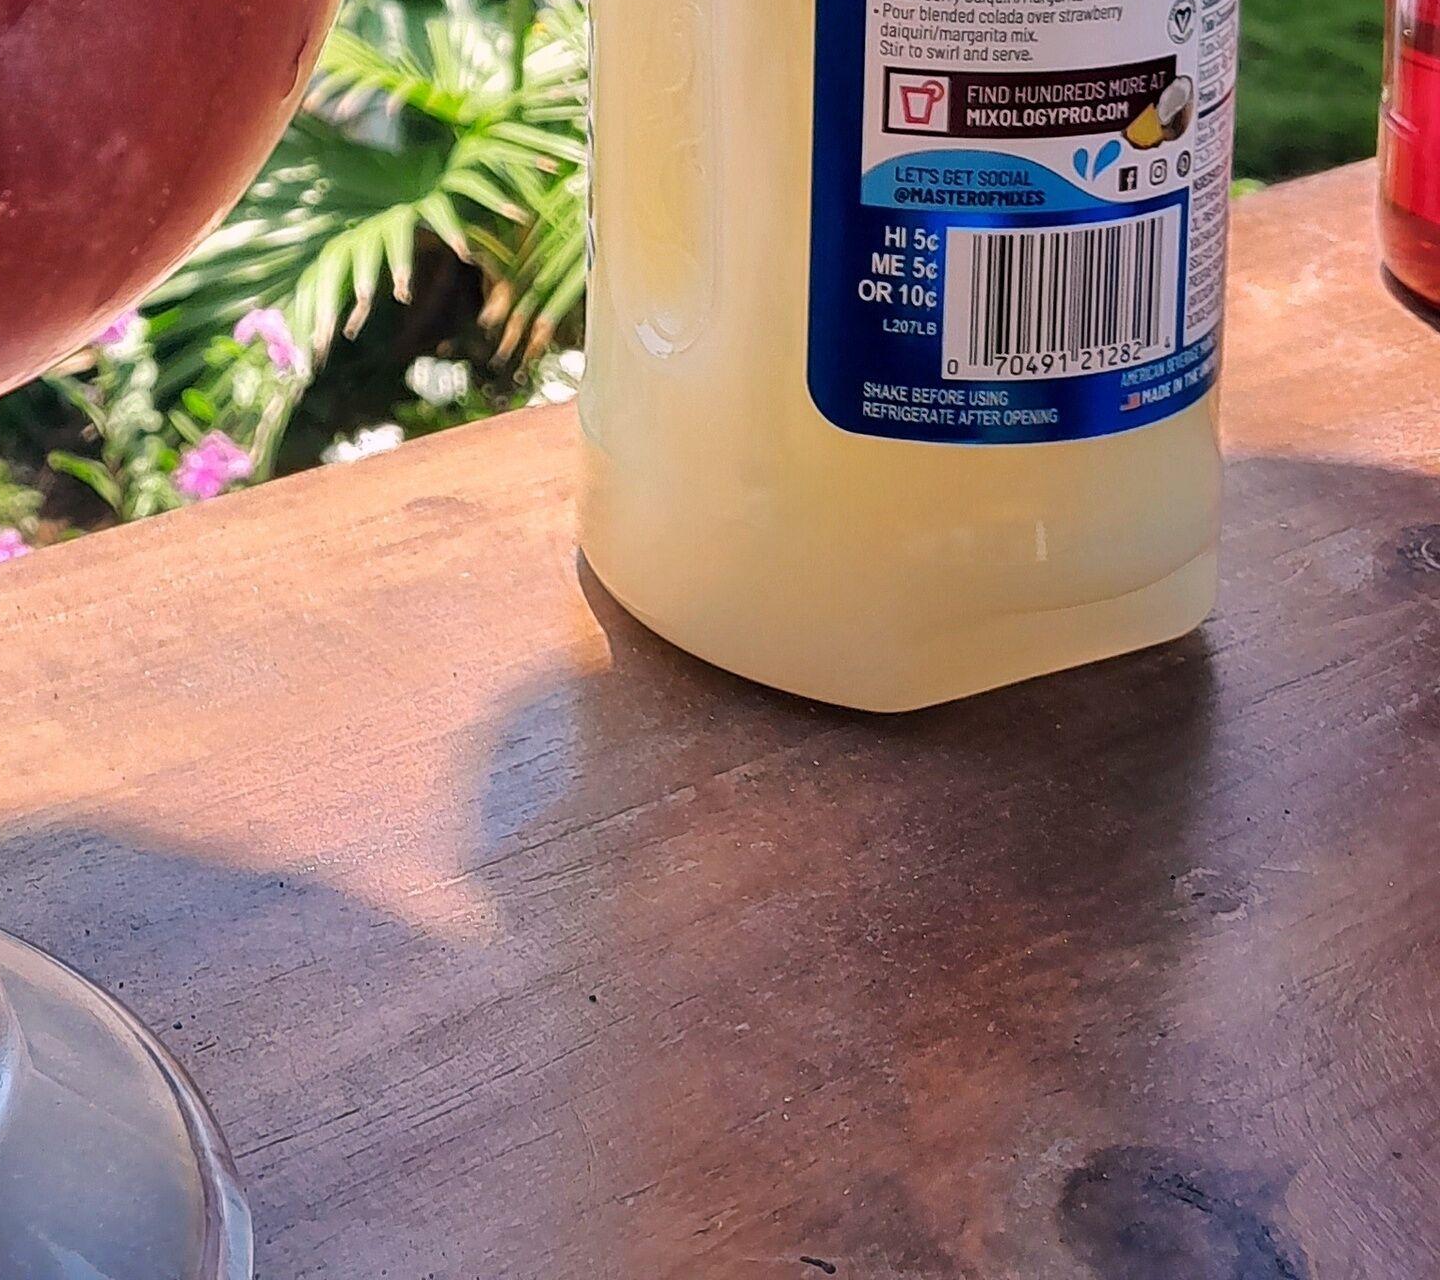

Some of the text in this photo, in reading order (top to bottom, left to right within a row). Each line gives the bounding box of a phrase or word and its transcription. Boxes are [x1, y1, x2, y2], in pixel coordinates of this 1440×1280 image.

[882, 4, 914, 20] Pour
[919, 6, 974, 23] blended
[978, 7, 1024, 24] colada
[1027, 10, 1054, 23] over
[926, 43, 959, 60] swirl
[964, 44, 988, 61] and
[992, 46, 1034, 61] serve.
[967, 72, 1167, 106] FIND HUNDREDS MORE AT
[966, 101, 1129, 128] MIXOLOGYPRO.COM
[896, 166, 1033, 186] LET'S GET SOCIAL
[894, 188, 1044, 206] @MASTEROFMIXES
[885, 225, 940, 252] HI 5¢
[871, 251, 938, 281] ME 5¢
[858, 279, 938, 310] OR 10¢
[946, 341, 1142, 375] 0 70491 21282
[863, 381, 1008, 406] SHAKE BEFORE USING
[863, 401, 1059, 426] REFRIGERATE AFTER OPENING
